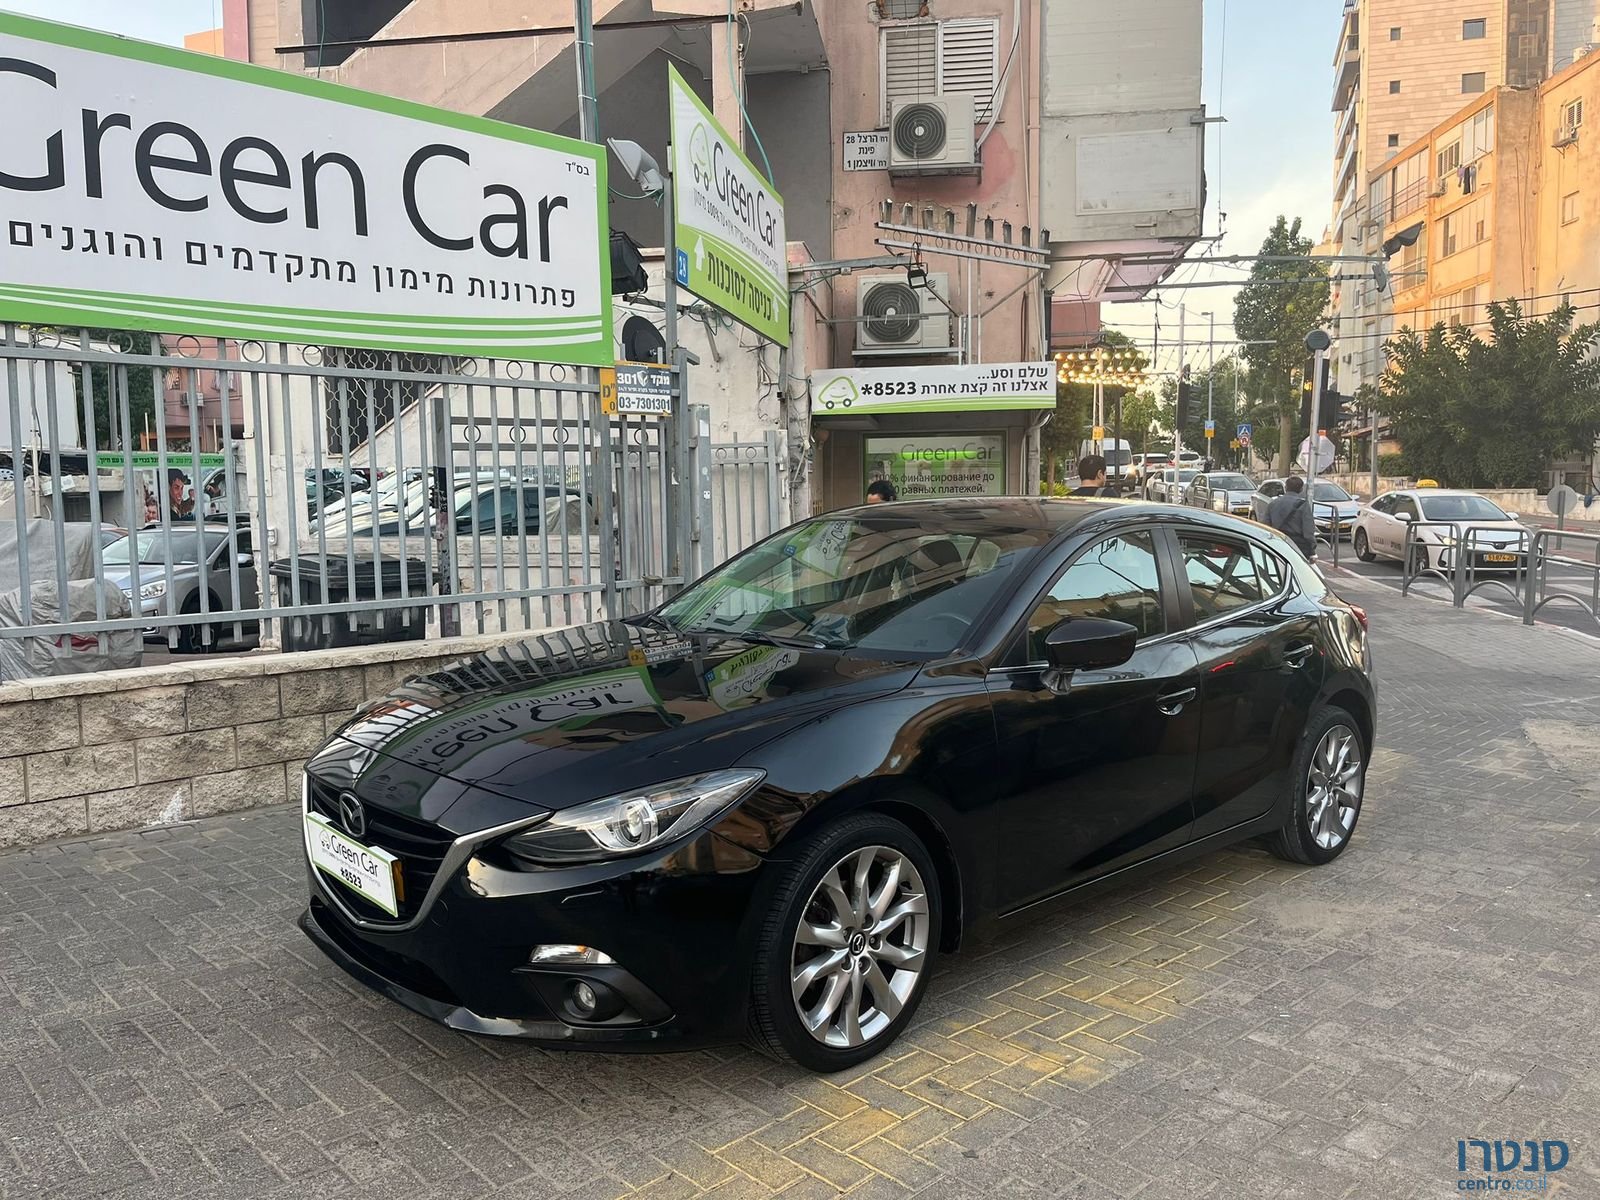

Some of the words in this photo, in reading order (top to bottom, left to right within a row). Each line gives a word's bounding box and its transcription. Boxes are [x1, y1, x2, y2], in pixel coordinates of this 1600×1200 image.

[846, 135, 855, 144] 28
[857, 133, 878, 143] הרצל
[858, 146, 875, 155] פינת
[0, 57, 369, 238] Green
[402, 143, 568, 263] Car
[847, 160, 851, 168] 1
[565, 161, 590, 176] בס"ד
[713, 141, 756, 232] Green
[757, 190, 777, 250] Car
[8, 220, 163, 261] והוגנים
[185, 241, 356, 283] מתקדמים
[372, 265, 454, 293] מימון
[707, 250, 746, 304] לסוכנות
[467, 277, 577, 308] פתרונות
[748, 282, 772, 321] כניסה
[616, 373, 637, 385] 301
[1018, 366, 1048, 378] שלם
[920, 384, 957, 395] אחרת
[960, 383, 988, 395] קצת
[992, 382, 1007, 392] זה
[1011, 379, 1048, 391] אצלנו
[618, 396, 670, 411] 03-7301301
[901, 443, 957, 461] Green
[963, 442, 995, 460] Car
[901, 472, 981, 483] финансирование
[983, 472, 995, 481] до
[901, 486, 936, 496] равных
[938, 483, 985, 494] платежей.
[330, 834, 360, 867] Green
[360, 852, 378, 877] Car
